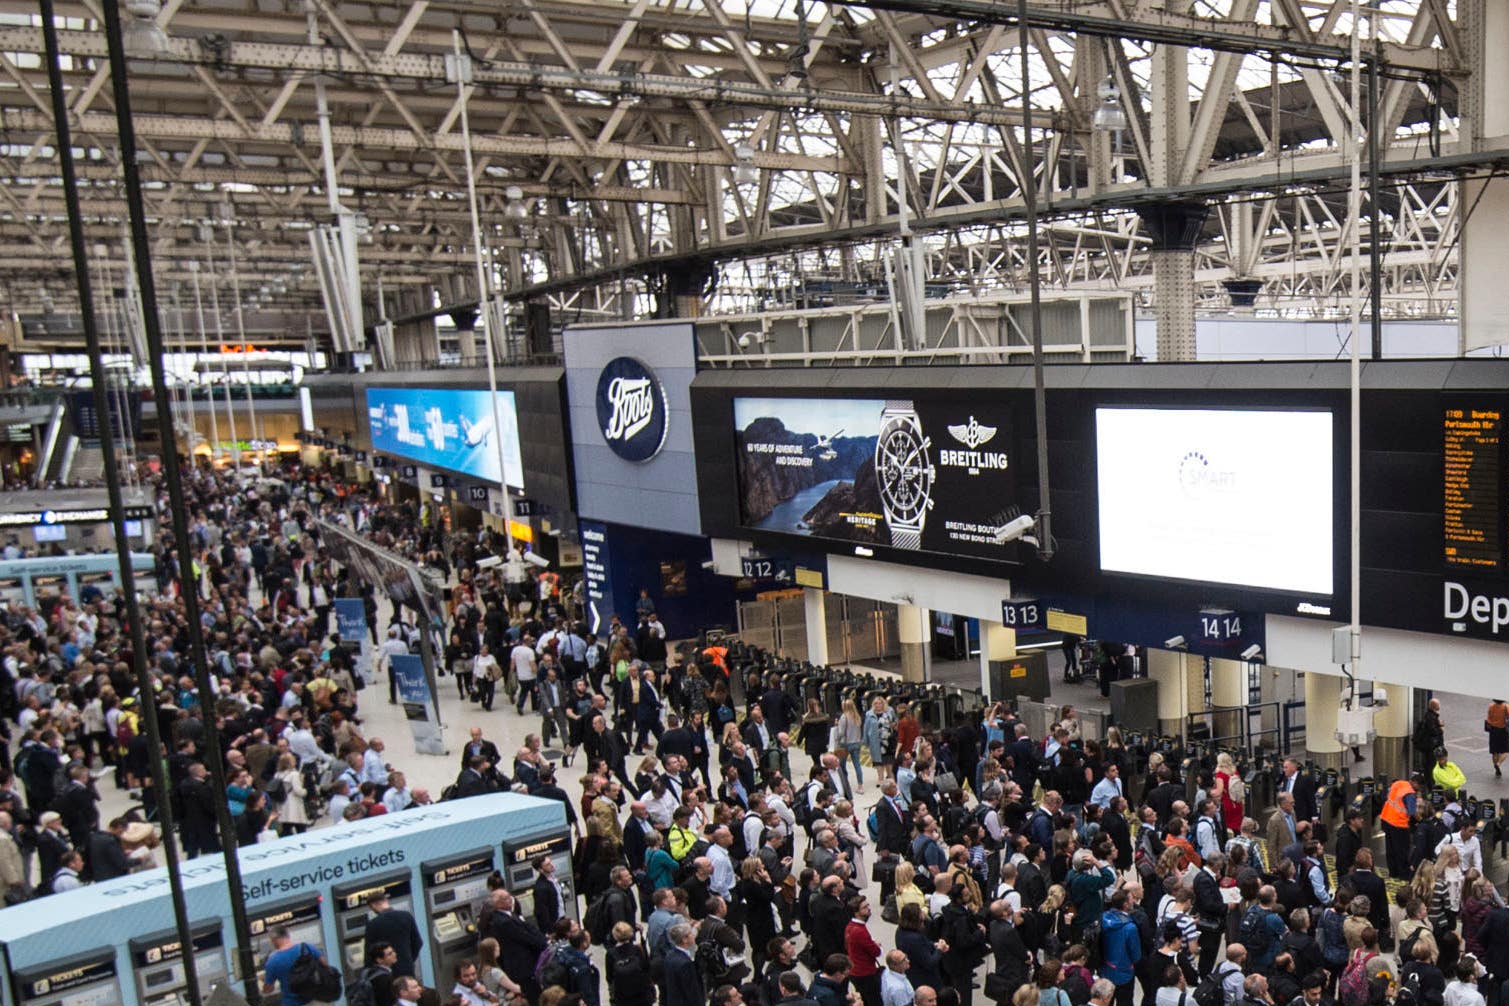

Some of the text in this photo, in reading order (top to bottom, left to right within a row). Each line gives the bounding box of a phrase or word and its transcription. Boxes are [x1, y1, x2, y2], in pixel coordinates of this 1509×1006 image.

[606, 376, 653, 441] Boots
[755, 443, 767, 453] YEARS
[768, 445, 774, 453] OF
[775, 445, 803, 454] ADVENTURE
[776, 456, 813, 467] AND DISCOVERY
[940, 450, 1008, 469] BREITLING
[406, 467, 413, 476] 8
[436, 476, 442, 486] 9
[472, 488, 485, 498] 10
[520, 502, 530, 513] 11
[847, 516, 876, 525] HERITAGE
[946, 521, 976, 532] BREITLING
[959, 533, 971, 541] NEW
[743, 562, 772, 577] 12 12
[1003, 606, 1038, 623] 13 13
[1201, 617, 1241, 639] 14 14
[526, 842, 548, 853] TICKETS
[241, 848, 406, 900] Self-service tickets
[446, 863, 470, 875] TICKETS
[265, 912, 293, 924] TICKETS
[50, 969, 84, 983] TICKETS
